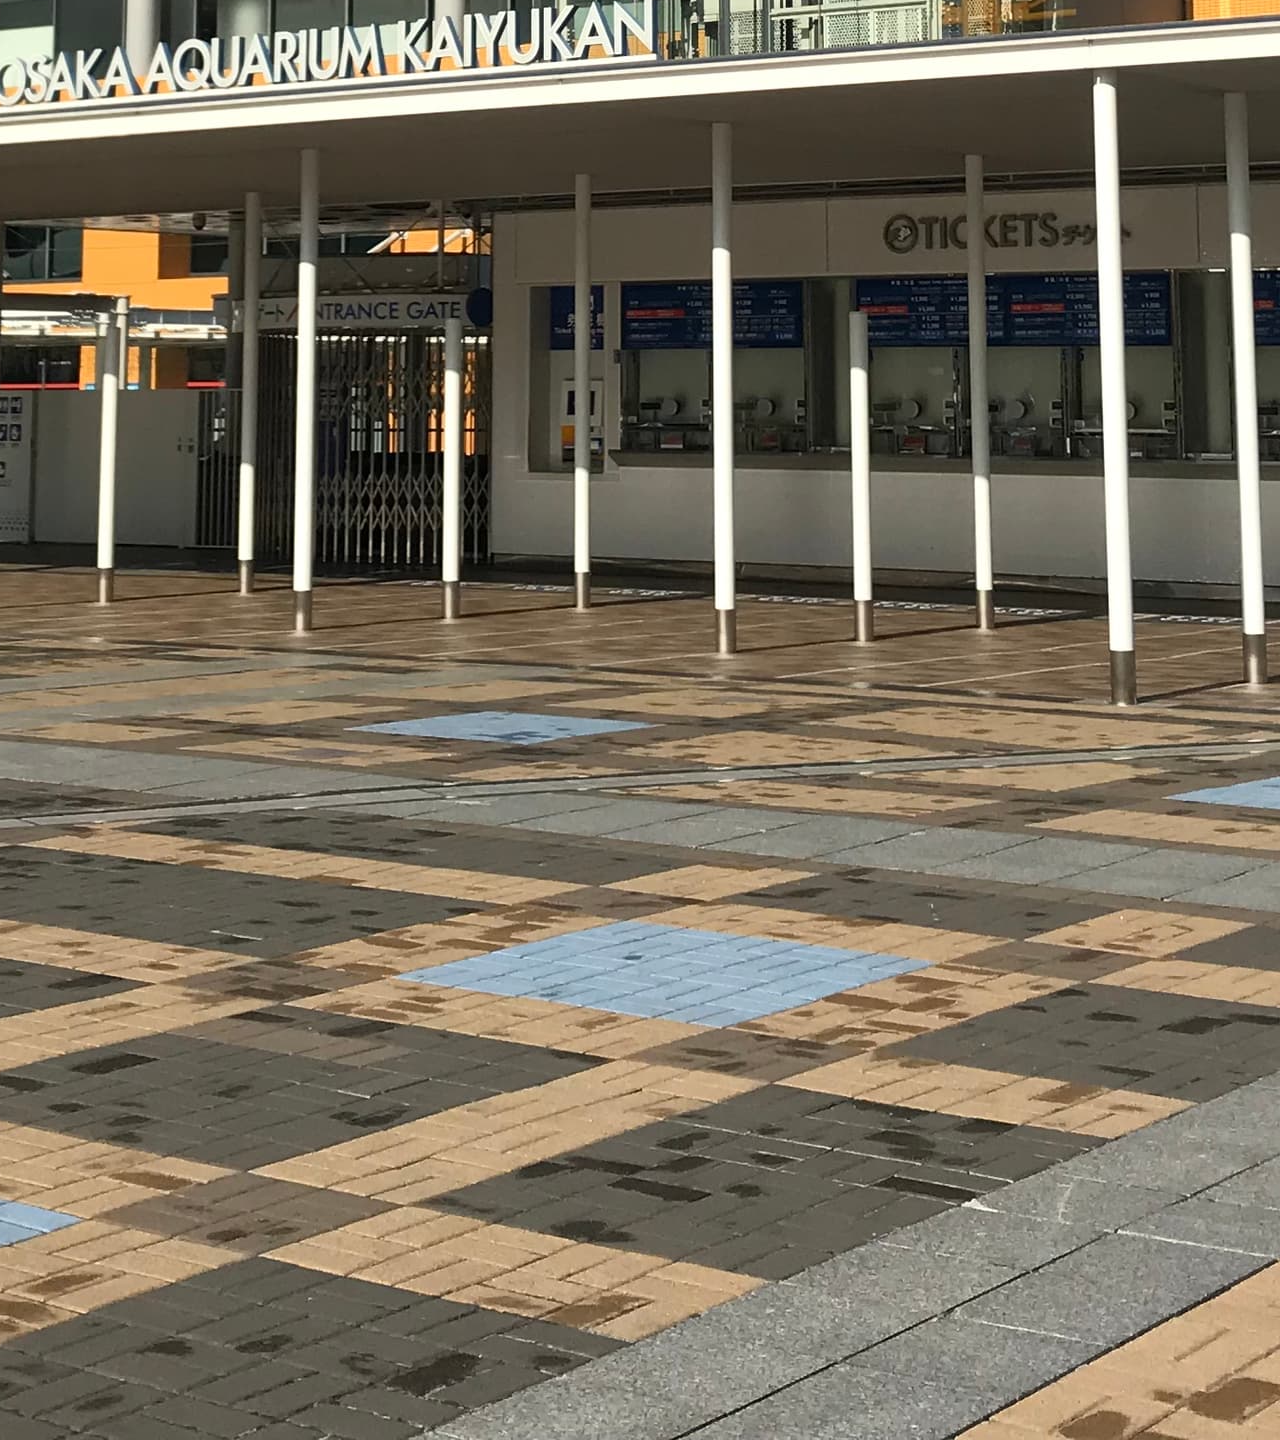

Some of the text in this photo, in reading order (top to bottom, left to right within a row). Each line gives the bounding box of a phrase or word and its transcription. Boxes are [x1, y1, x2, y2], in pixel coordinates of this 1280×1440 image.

[143, 22, 387, 95] AQUARIUM
[917, 212, 1060, 250] TICKETS
[315, 301, 401, 322] NTRANCE
[406, 300, 462, 321] GATE
